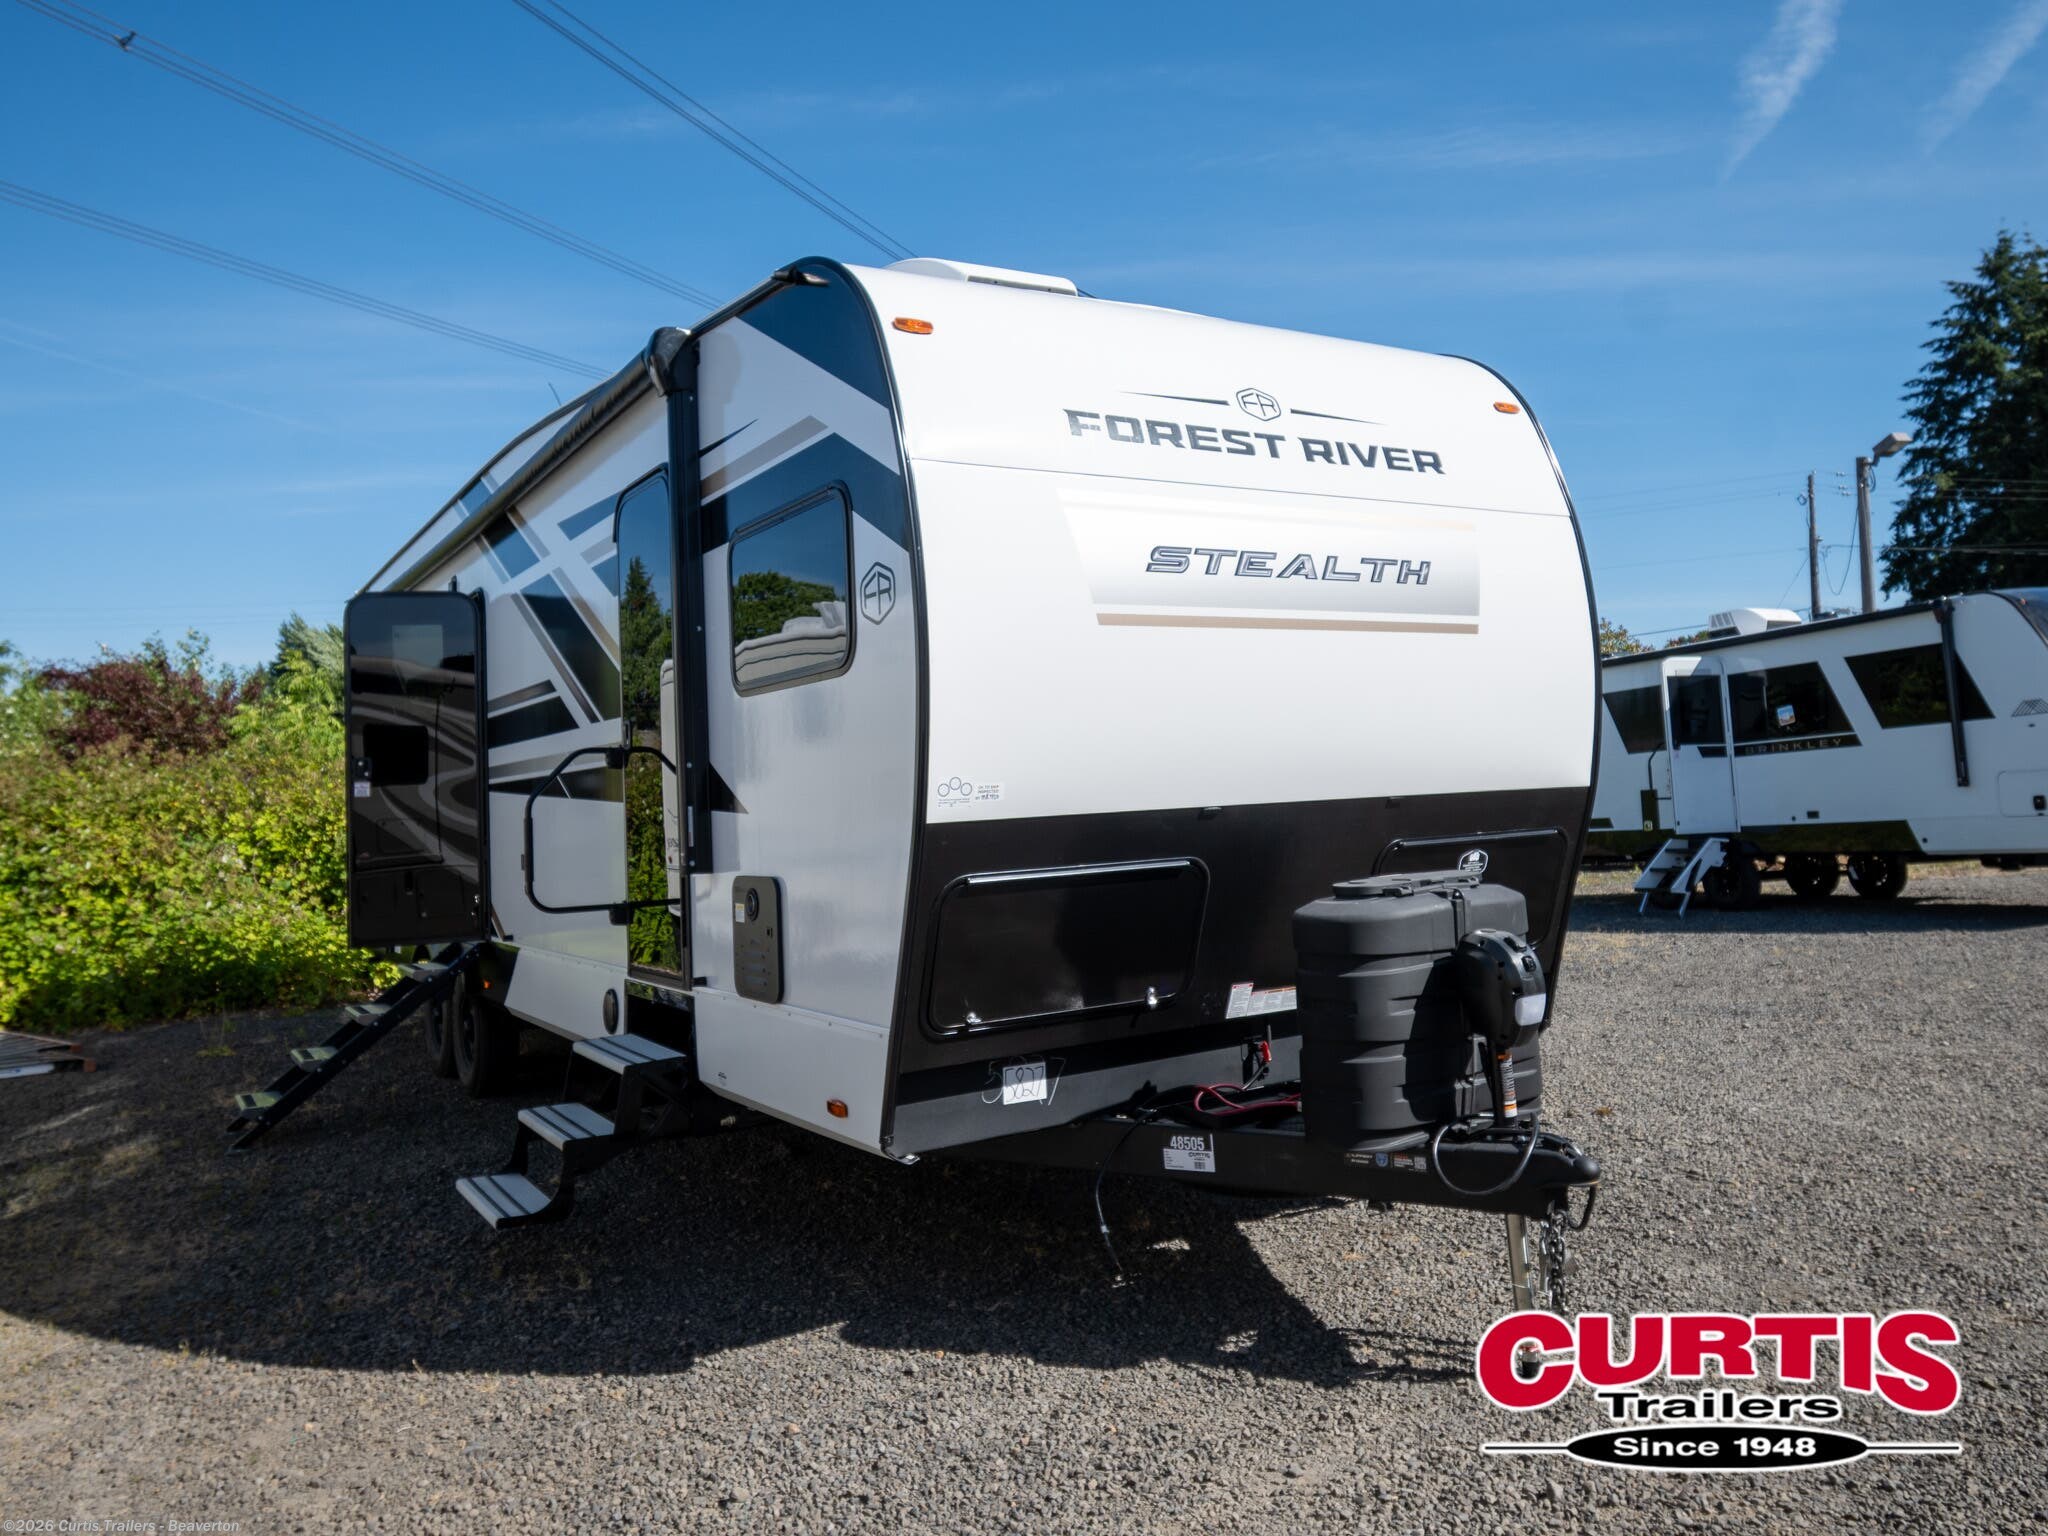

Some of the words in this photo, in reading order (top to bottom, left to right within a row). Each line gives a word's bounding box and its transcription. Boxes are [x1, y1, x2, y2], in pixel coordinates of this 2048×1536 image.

[1062, 408, 1287, 459] FOREST
[1297, 436, 1447, 475] RIVER
[1145, 544, 1432, 586] STEALTH
[1745, 738, 1841, 754] BRINKLEY
[1170, 1135, 1205, 1151] 48505
